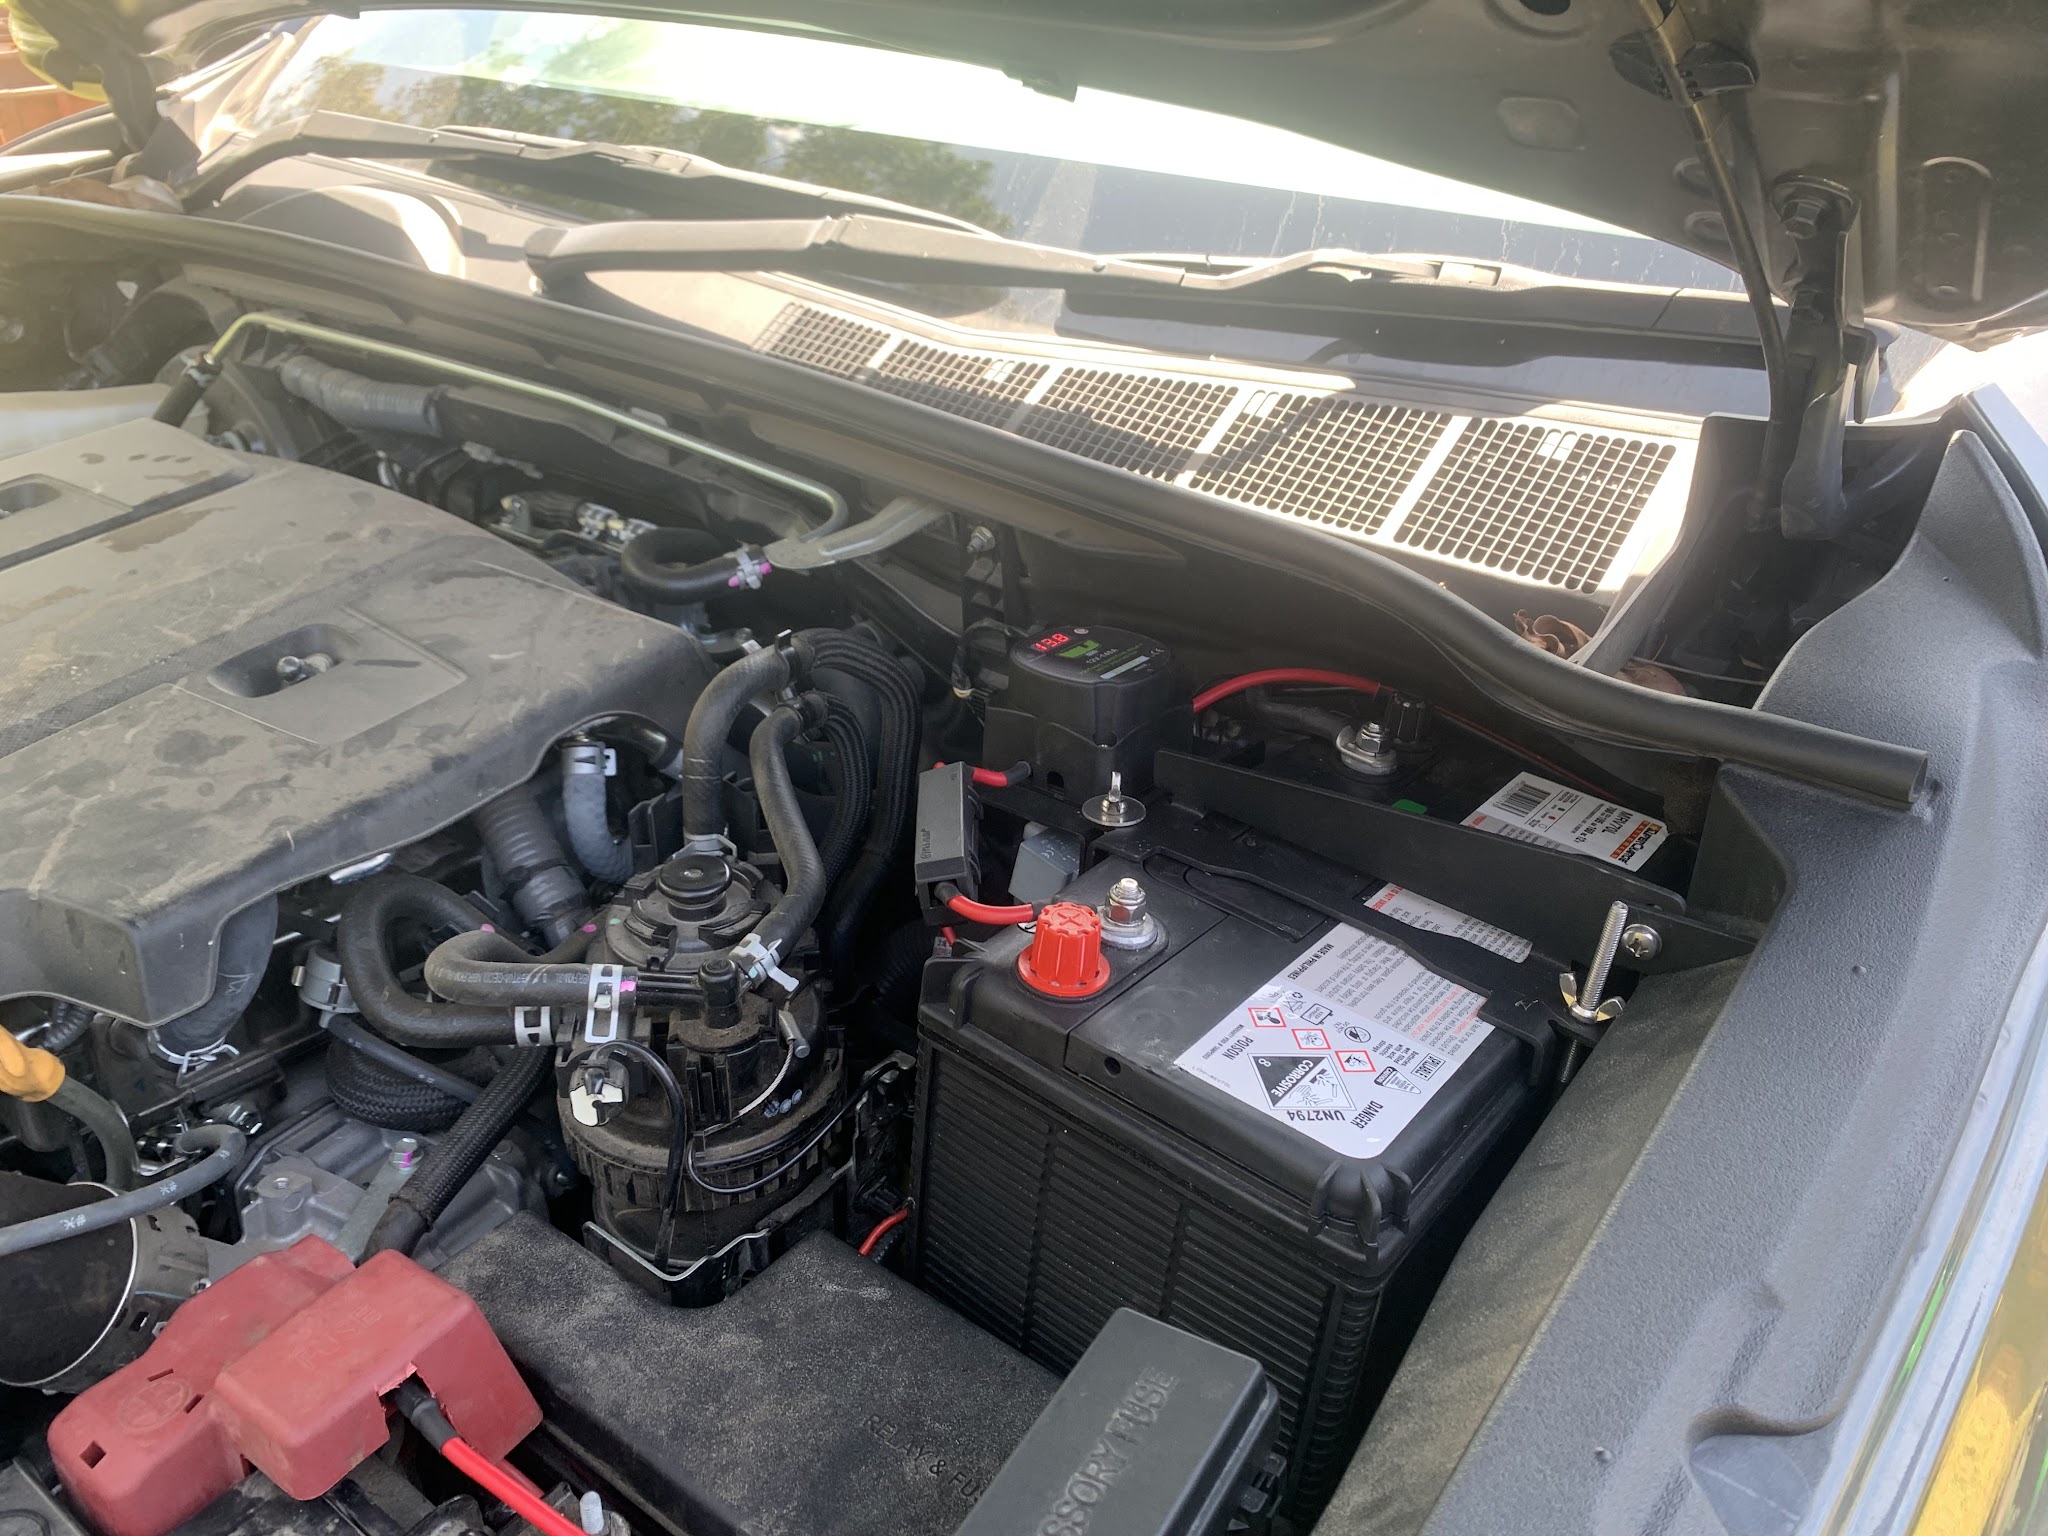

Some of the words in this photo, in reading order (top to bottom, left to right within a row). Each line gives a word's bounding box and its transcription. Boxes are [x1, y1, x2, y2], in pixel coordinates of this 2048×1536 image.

[1032, 632, 1070, 652] 13.8
[1601, 810, 1633, 834] MRV70L
[1311, 952, 1322, 960] IN
[1316, 942, 1334, 955] MADE
[1286, 956, 1317, 980] PHILIPPINES
[1220, 1035, 1254, 1060] POISON
[1256, 1057, 1272, 1067] 8
[1414, 1055, 1441, 1078] SPILLABLE
[1269, 1058, 1315, 1097] CORROSIVE
[1286, 1109, 1346, 1121] UN2794
[1349, 1100, 1384, 1129] DANGER
[1104, 1366, 1180, 1446] FUSE
[862, 1412, 933, 1463] RELAY
[929, 1459, 947, 1477] &
